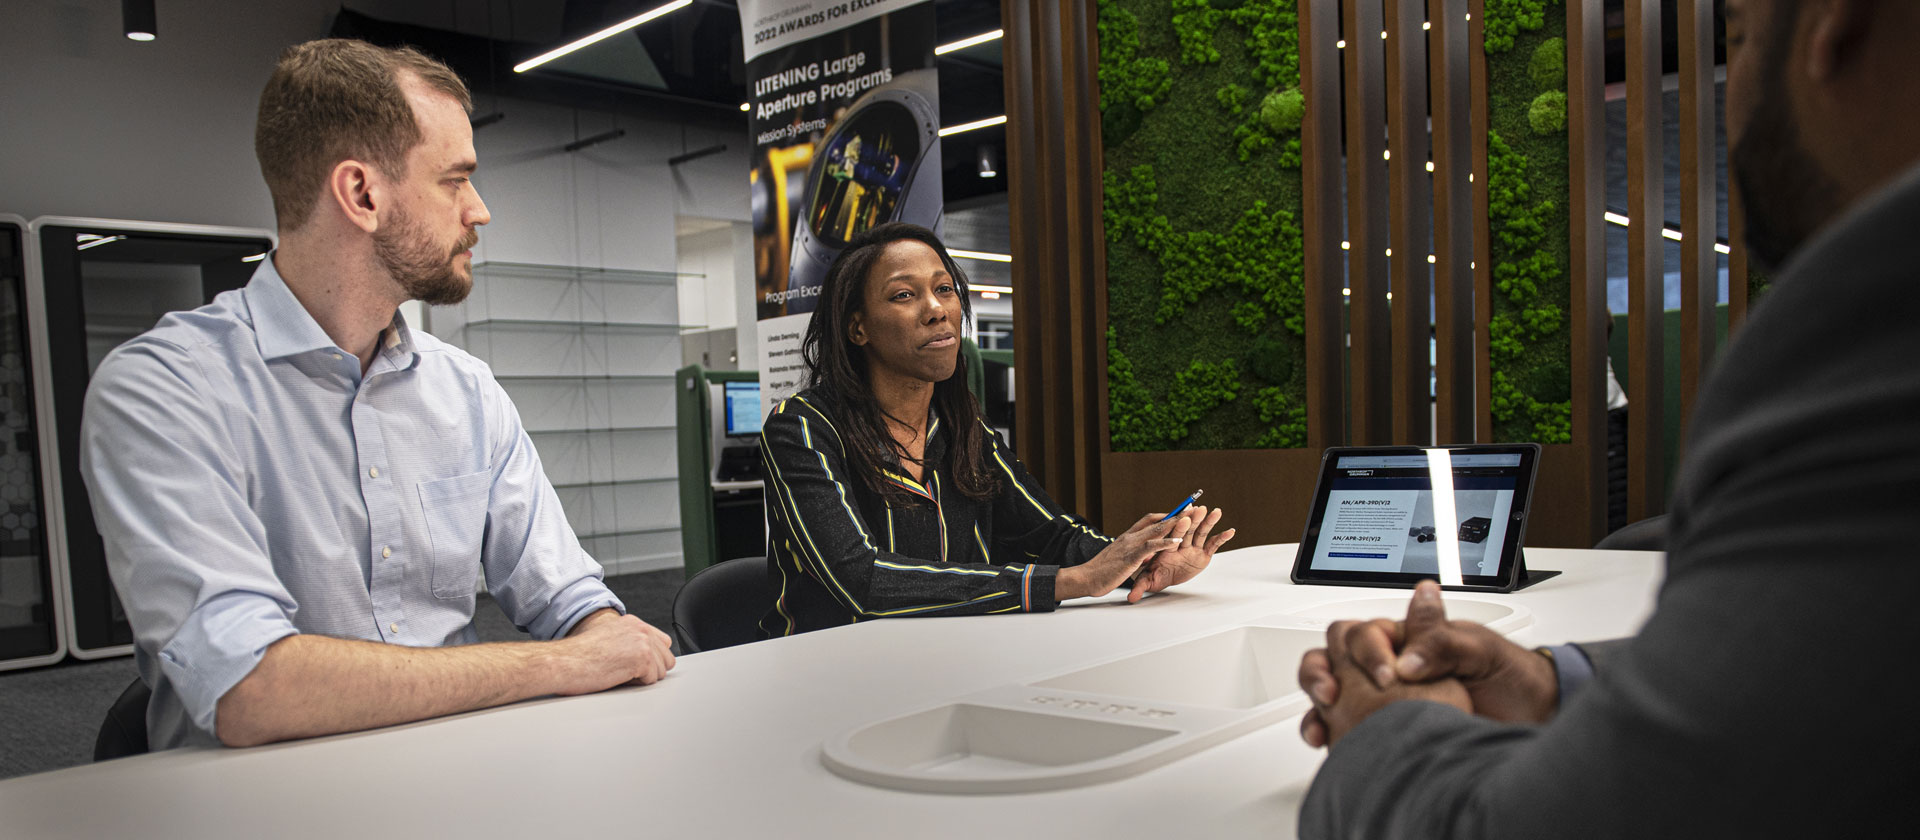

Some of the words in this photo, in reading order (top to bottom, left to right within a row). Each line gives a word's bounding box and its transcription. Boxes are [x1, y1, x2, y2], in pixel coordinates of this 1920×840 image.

[754, 26, 777, 44] 2022
[779, 10, 825, 35] AWARDS
[827, 3, 849, 21] FOR
[755, 62, 820, 97] LITENING
[823, 51, 866, 77] Large
[756, 89, 817, 120] Aperture
[820, 67, 893, 101] Programs
[757, 127, 787, 146] Mission
[787, 117, 827, 137] Systems
[765, 288, 800, 304] Program
